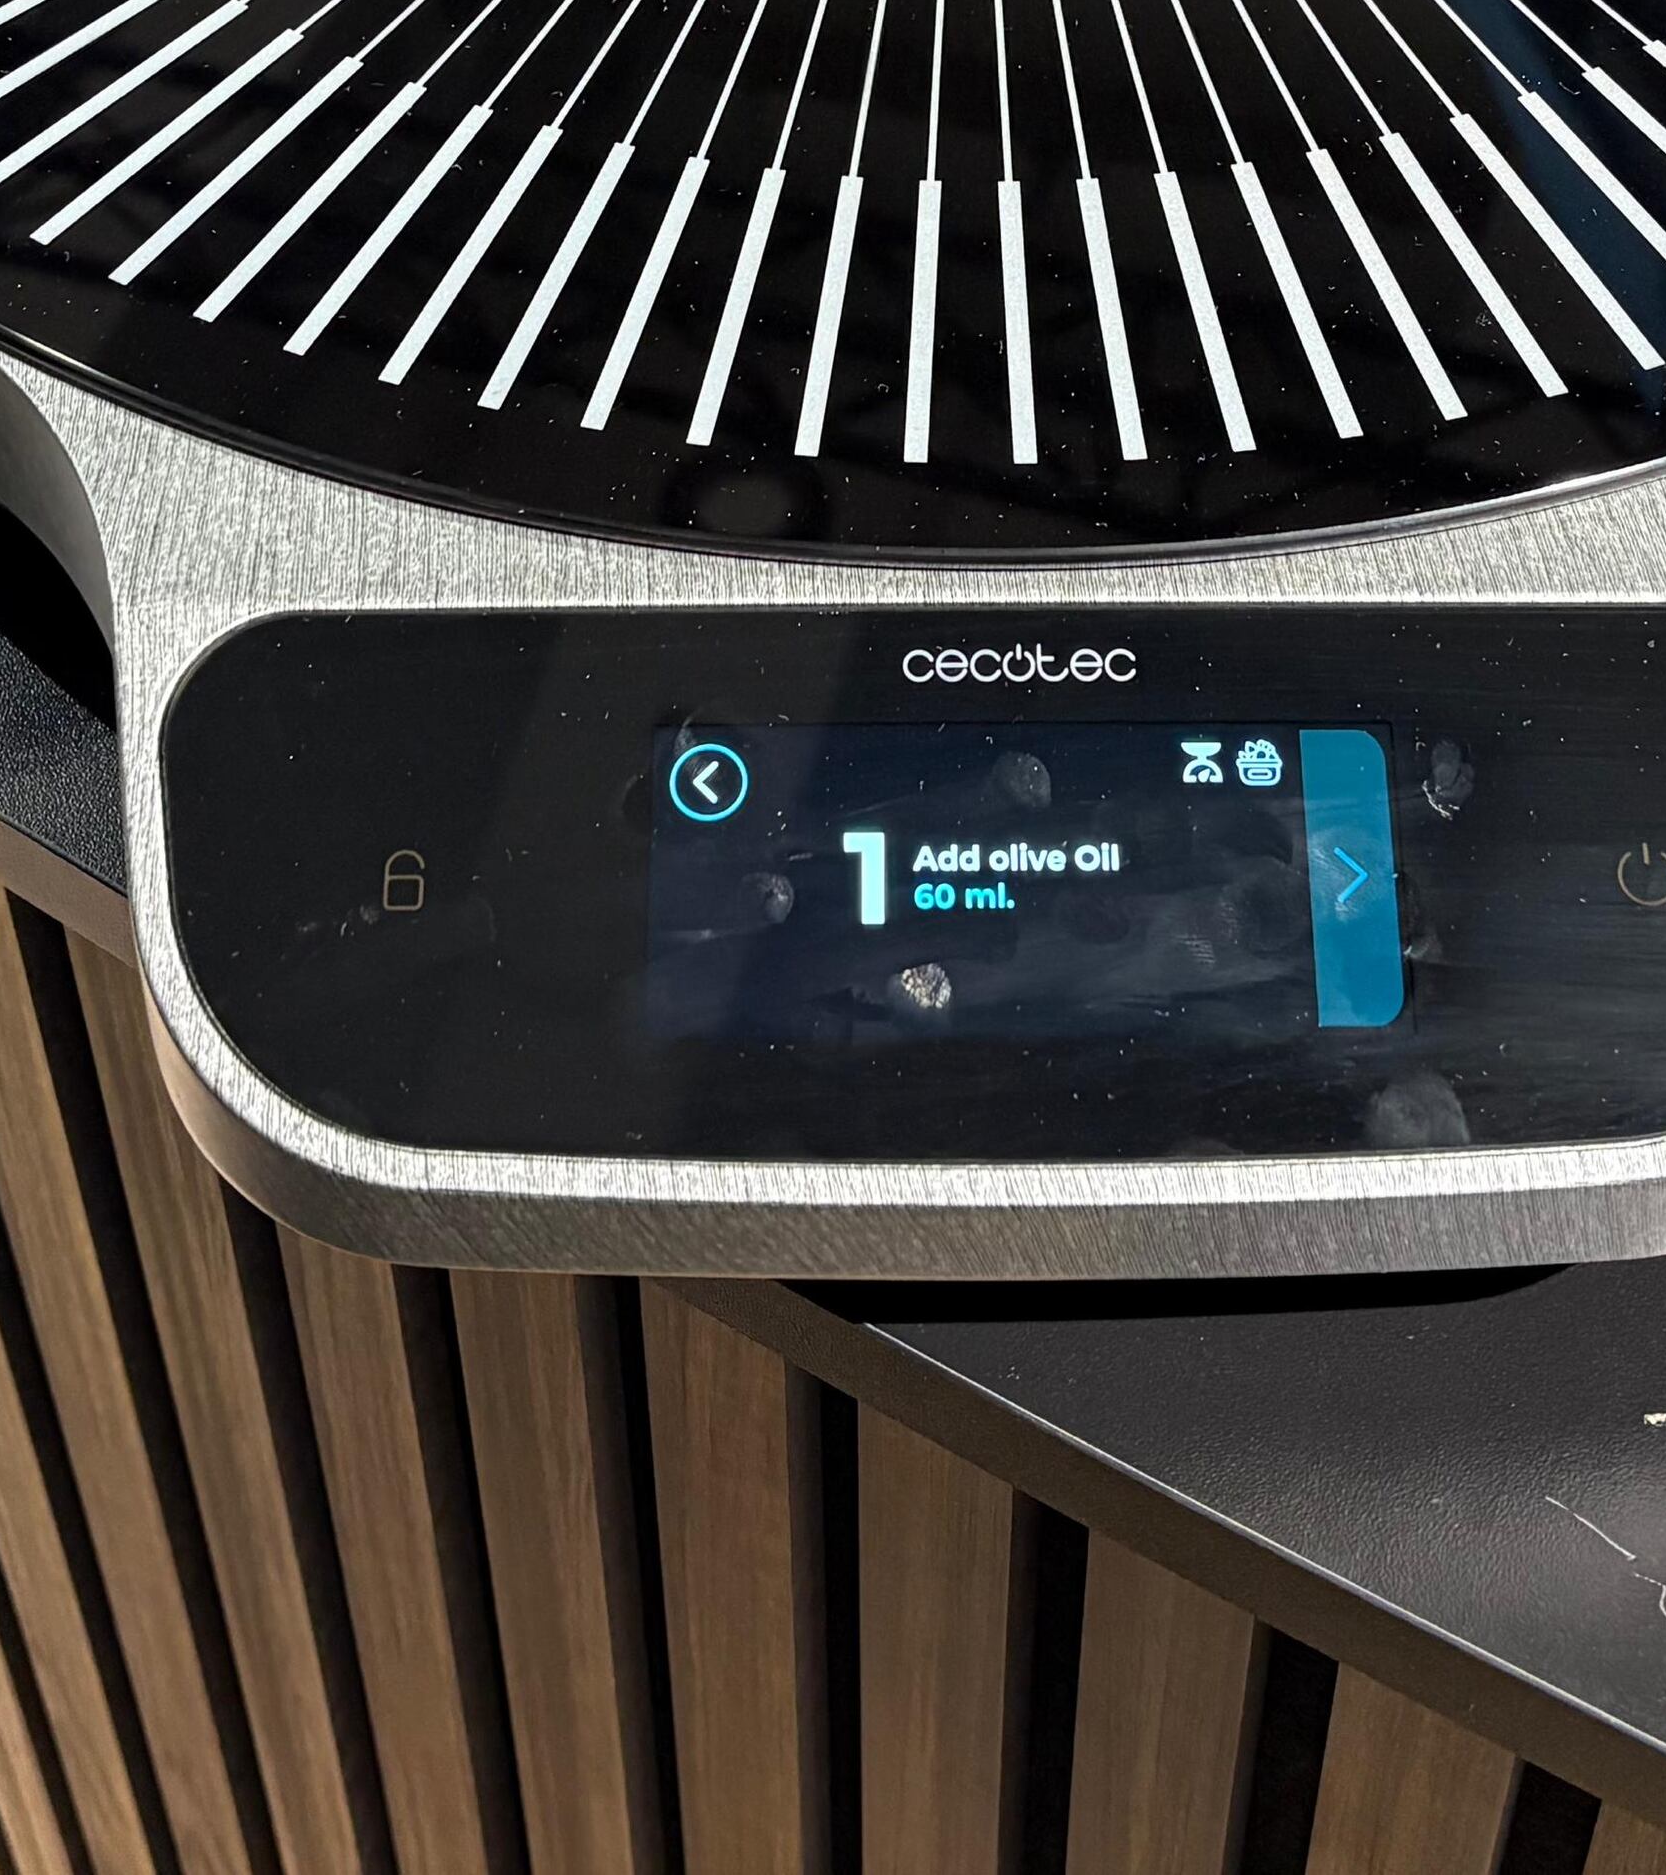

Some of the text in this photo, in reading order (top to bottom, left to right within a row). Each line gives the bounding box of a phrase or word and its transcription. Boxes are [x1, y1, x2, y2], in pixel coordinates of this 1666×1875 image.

[902, 643, 1137, 683] cecotec
[913, 844, 1120, 872] Add olive Oil
[843, 831, 886, 925] 1
[915, 883, 1015, 910] 60 ml.
